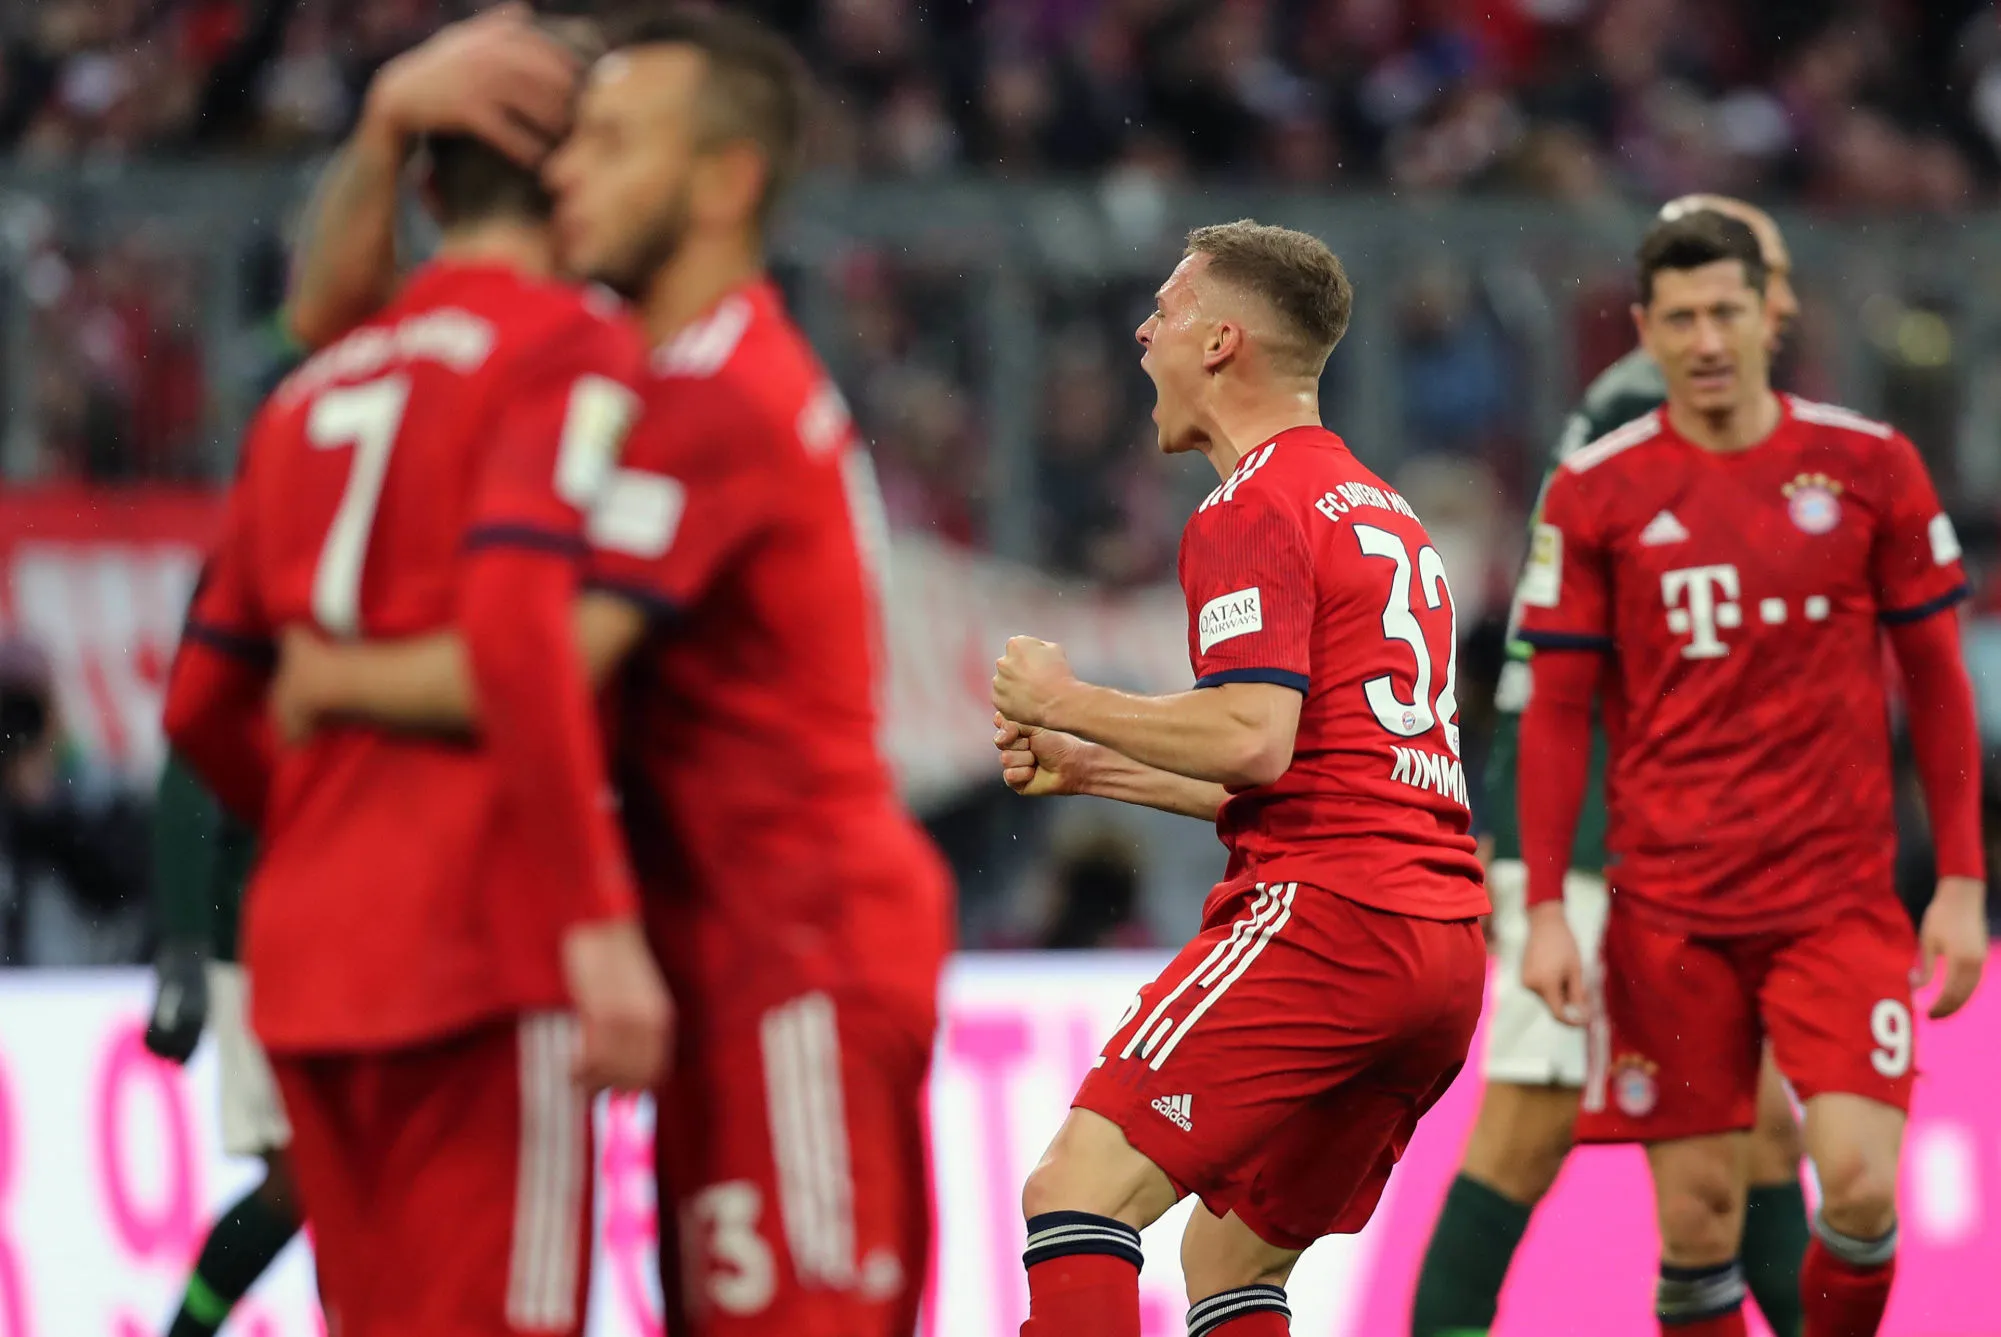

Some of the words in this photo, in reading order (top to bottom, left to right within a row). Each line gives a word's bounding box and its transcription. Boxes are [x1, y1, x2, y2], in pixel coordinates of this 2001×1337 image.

[307, 373, 410, 638] 7
[1314, 491, 1350, 523] FC
[1200, 597, 1256, 633] QATAR
[1208, 614, 1258, 636] AIRWAYS
[1352, 523, 1460, 758] 32
[1870, 998, 1912, 1077] 9
[1151, 1098, 1193, 1132] adidas
